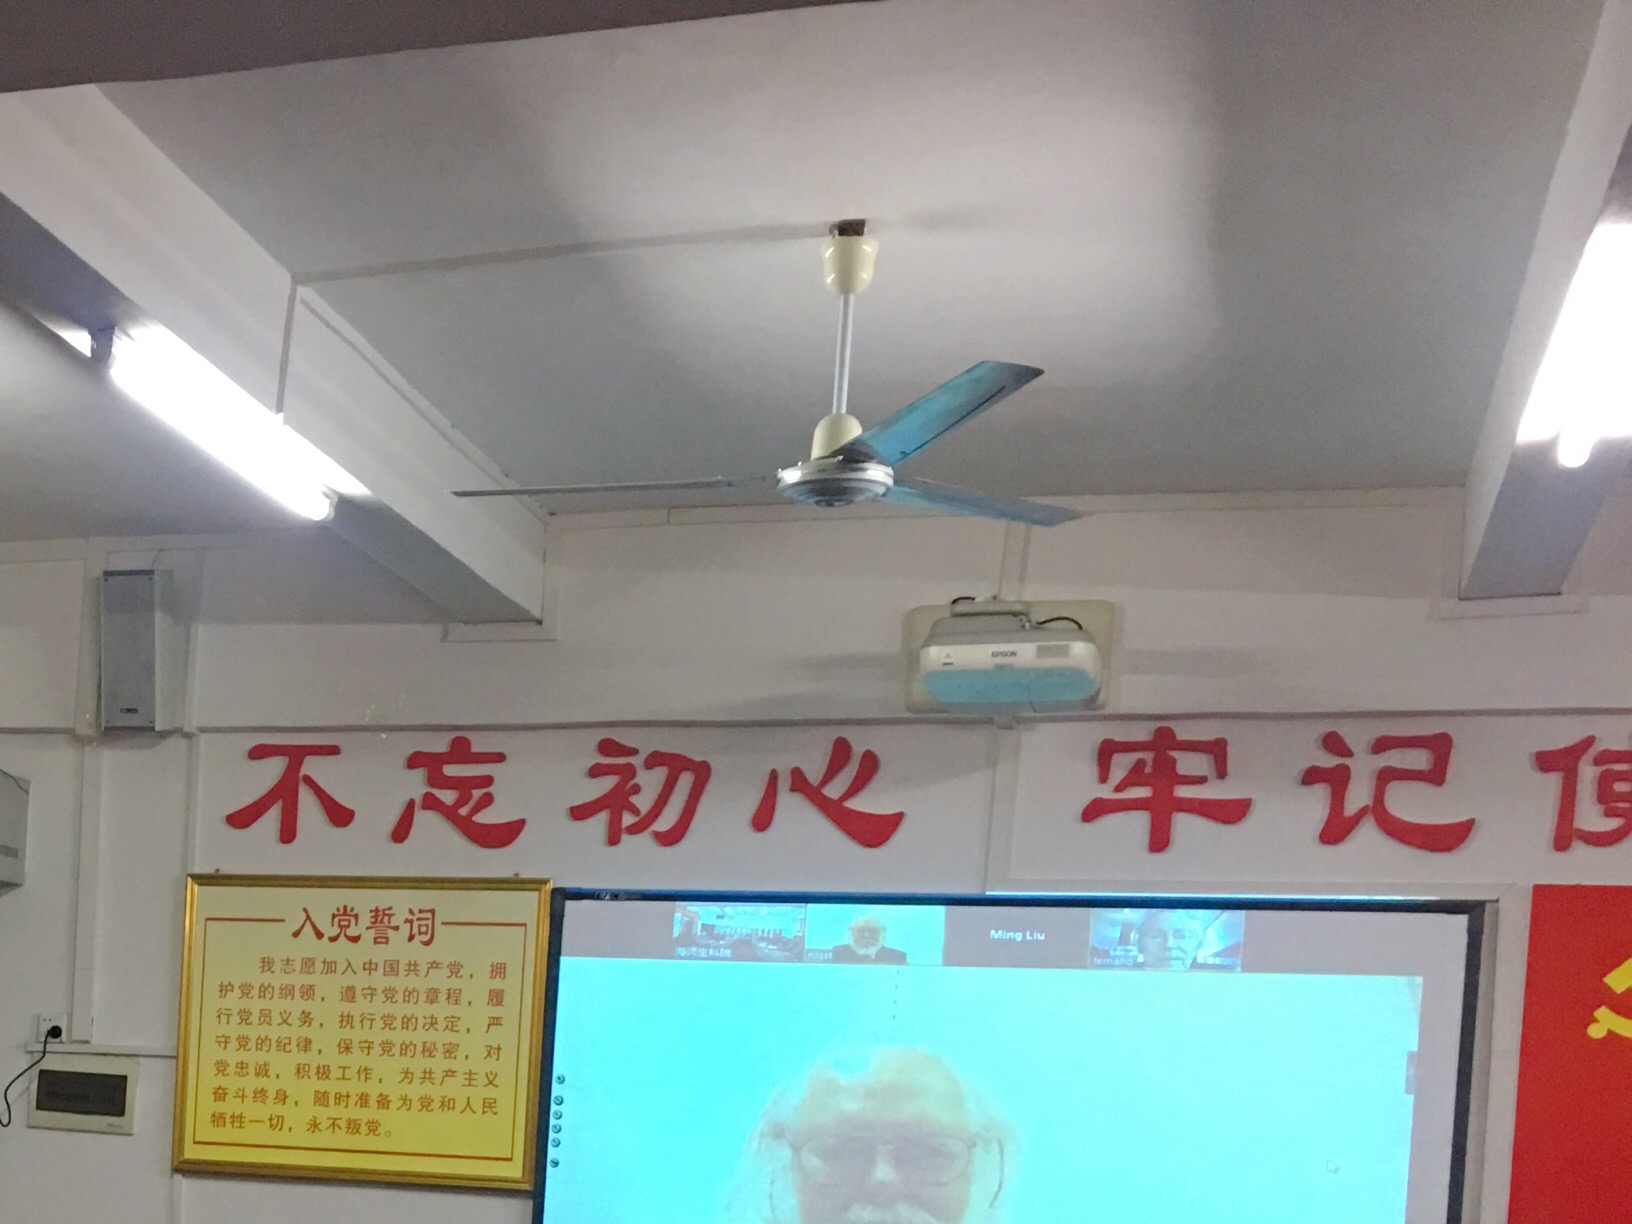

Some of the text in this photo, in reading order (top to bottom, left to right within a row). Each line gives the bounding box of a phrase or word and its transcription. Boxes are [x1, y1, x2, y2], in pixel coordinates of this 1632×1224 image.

[225, 735, 907, 848] 不忘初心
[291, 904, 437, 946] 入党誓词
[990, 929, 1046, 942] Ming Liu
